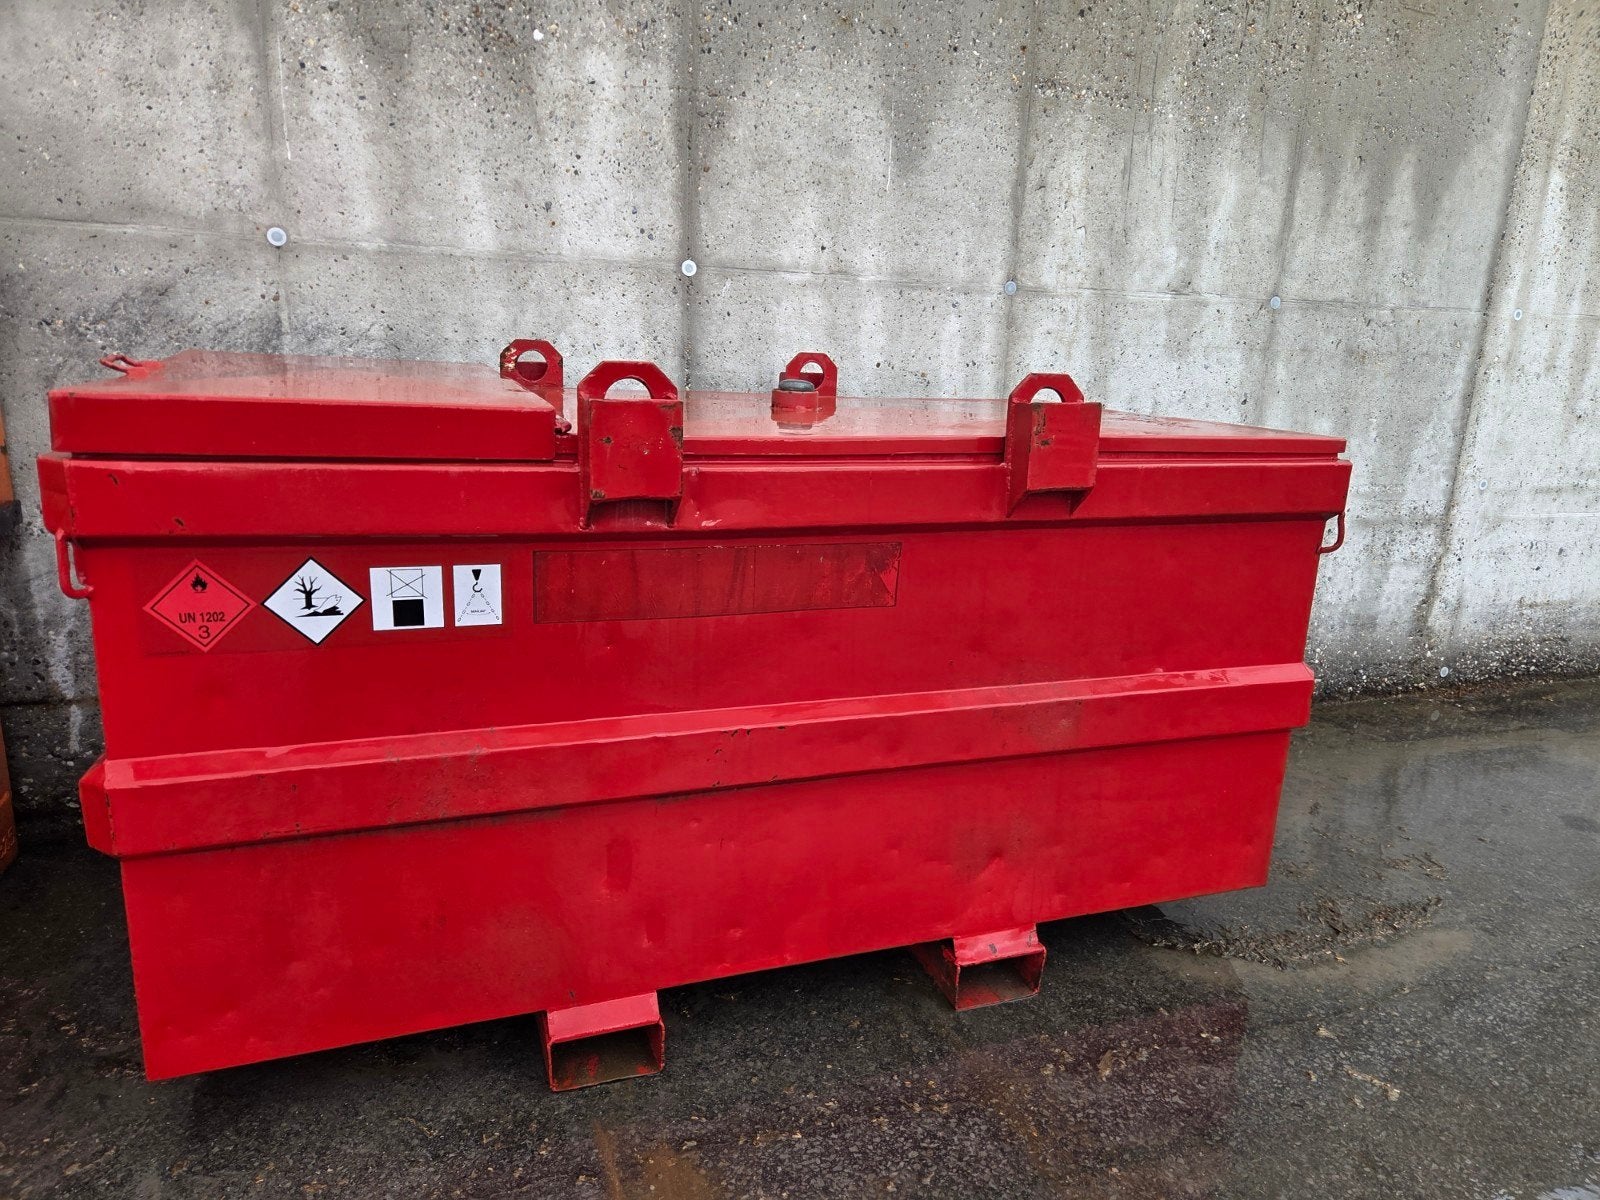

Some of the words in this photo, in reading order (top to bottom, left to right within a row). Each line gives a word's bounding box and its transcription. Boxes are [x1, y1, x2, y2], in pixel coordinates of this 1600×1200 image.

[178, 612, 196, 623] UN
[199, 611, 225, 622] 1202
[198, 625, 211, 639] 3
